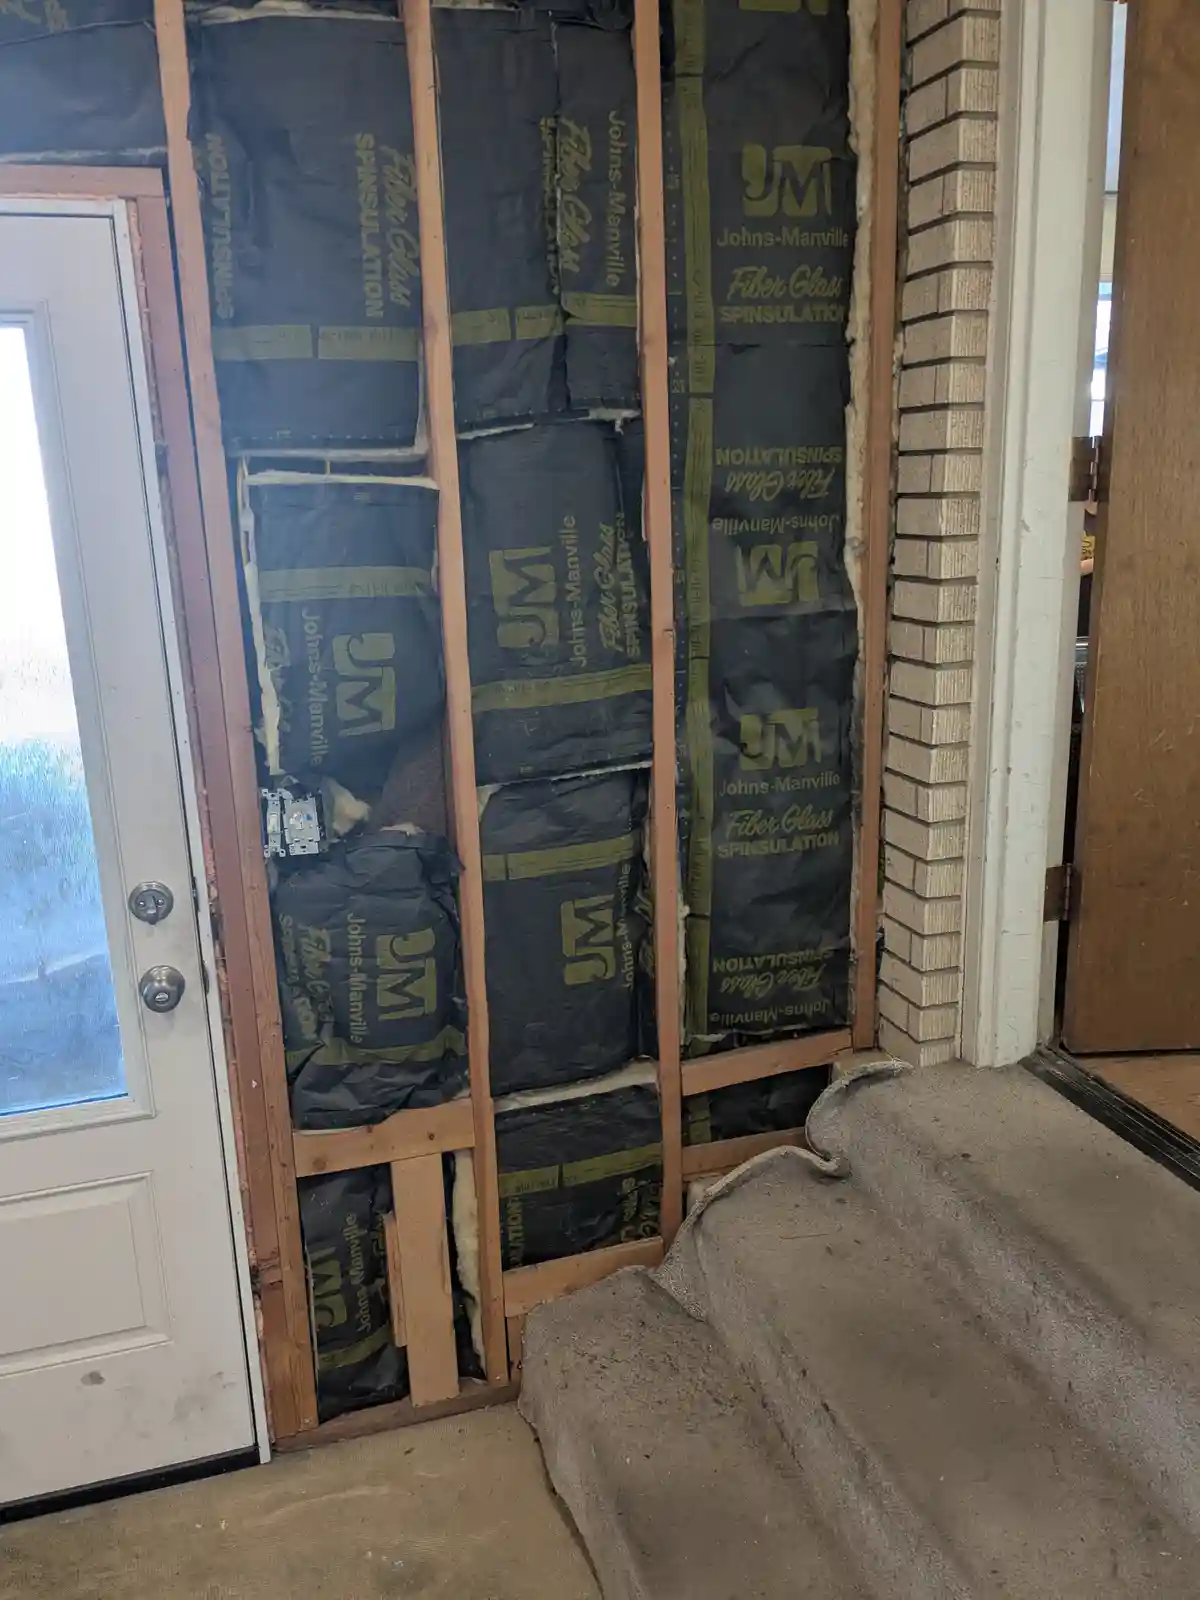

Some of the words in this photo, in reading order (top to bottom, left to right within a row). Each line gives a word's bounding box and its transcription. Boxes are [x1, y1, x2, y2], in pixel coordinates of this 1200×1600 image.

[557, 116, 593, 193] Fiber
[741, 144, 832, 218] JM
[205, 132, 236, 320] SPINSULATION
[354, 132, 386, 319] SPINSULATION
[607, 109, 628, 288] Johns-Manville
[386, 224, 421, 308] Glass
[560, 197, 593, 273] Glass
[716, 226, 849, 247] Johns-Manville
[727, 264, 787, 301] Fiber
[786, 263, 845, 299] Glass
[715, 445, 843, 467] SPINSULATION
[725, 469, 784, 502] Glass
[787, 468, 835, 499] Fiber
[592, 521, 617, 590] Glass
[711, 513, 841, 538] Johns-Manville
[488, 546, 561, 650] JM
[559, 514, 588, 669] Johns-Manville
[736, 541, 820, 607] JM
[597, 589, 627, 652] Fiber
[302, 607, 331, 768] Johns-Manville
[333, 632, 396, 738] JM
[738, 707, 823, 773] JM
[718, 770, 842, 799] Johns-Manville
[716, 830, 841, 860] SPINSULATION
[725, 807, 781, 839] Fiber
[780, 803, 835, 834] Glass
[560, 895, 617, 986] JM
[346, 912, 369, 1045] Johns-Manville
[376, 927, 438, 1022] JM
[720, 971, 775, 999] Glass
[777, 963, 826, 991] Fiber
[709, 998, 832, 1026] Johns-Manville
